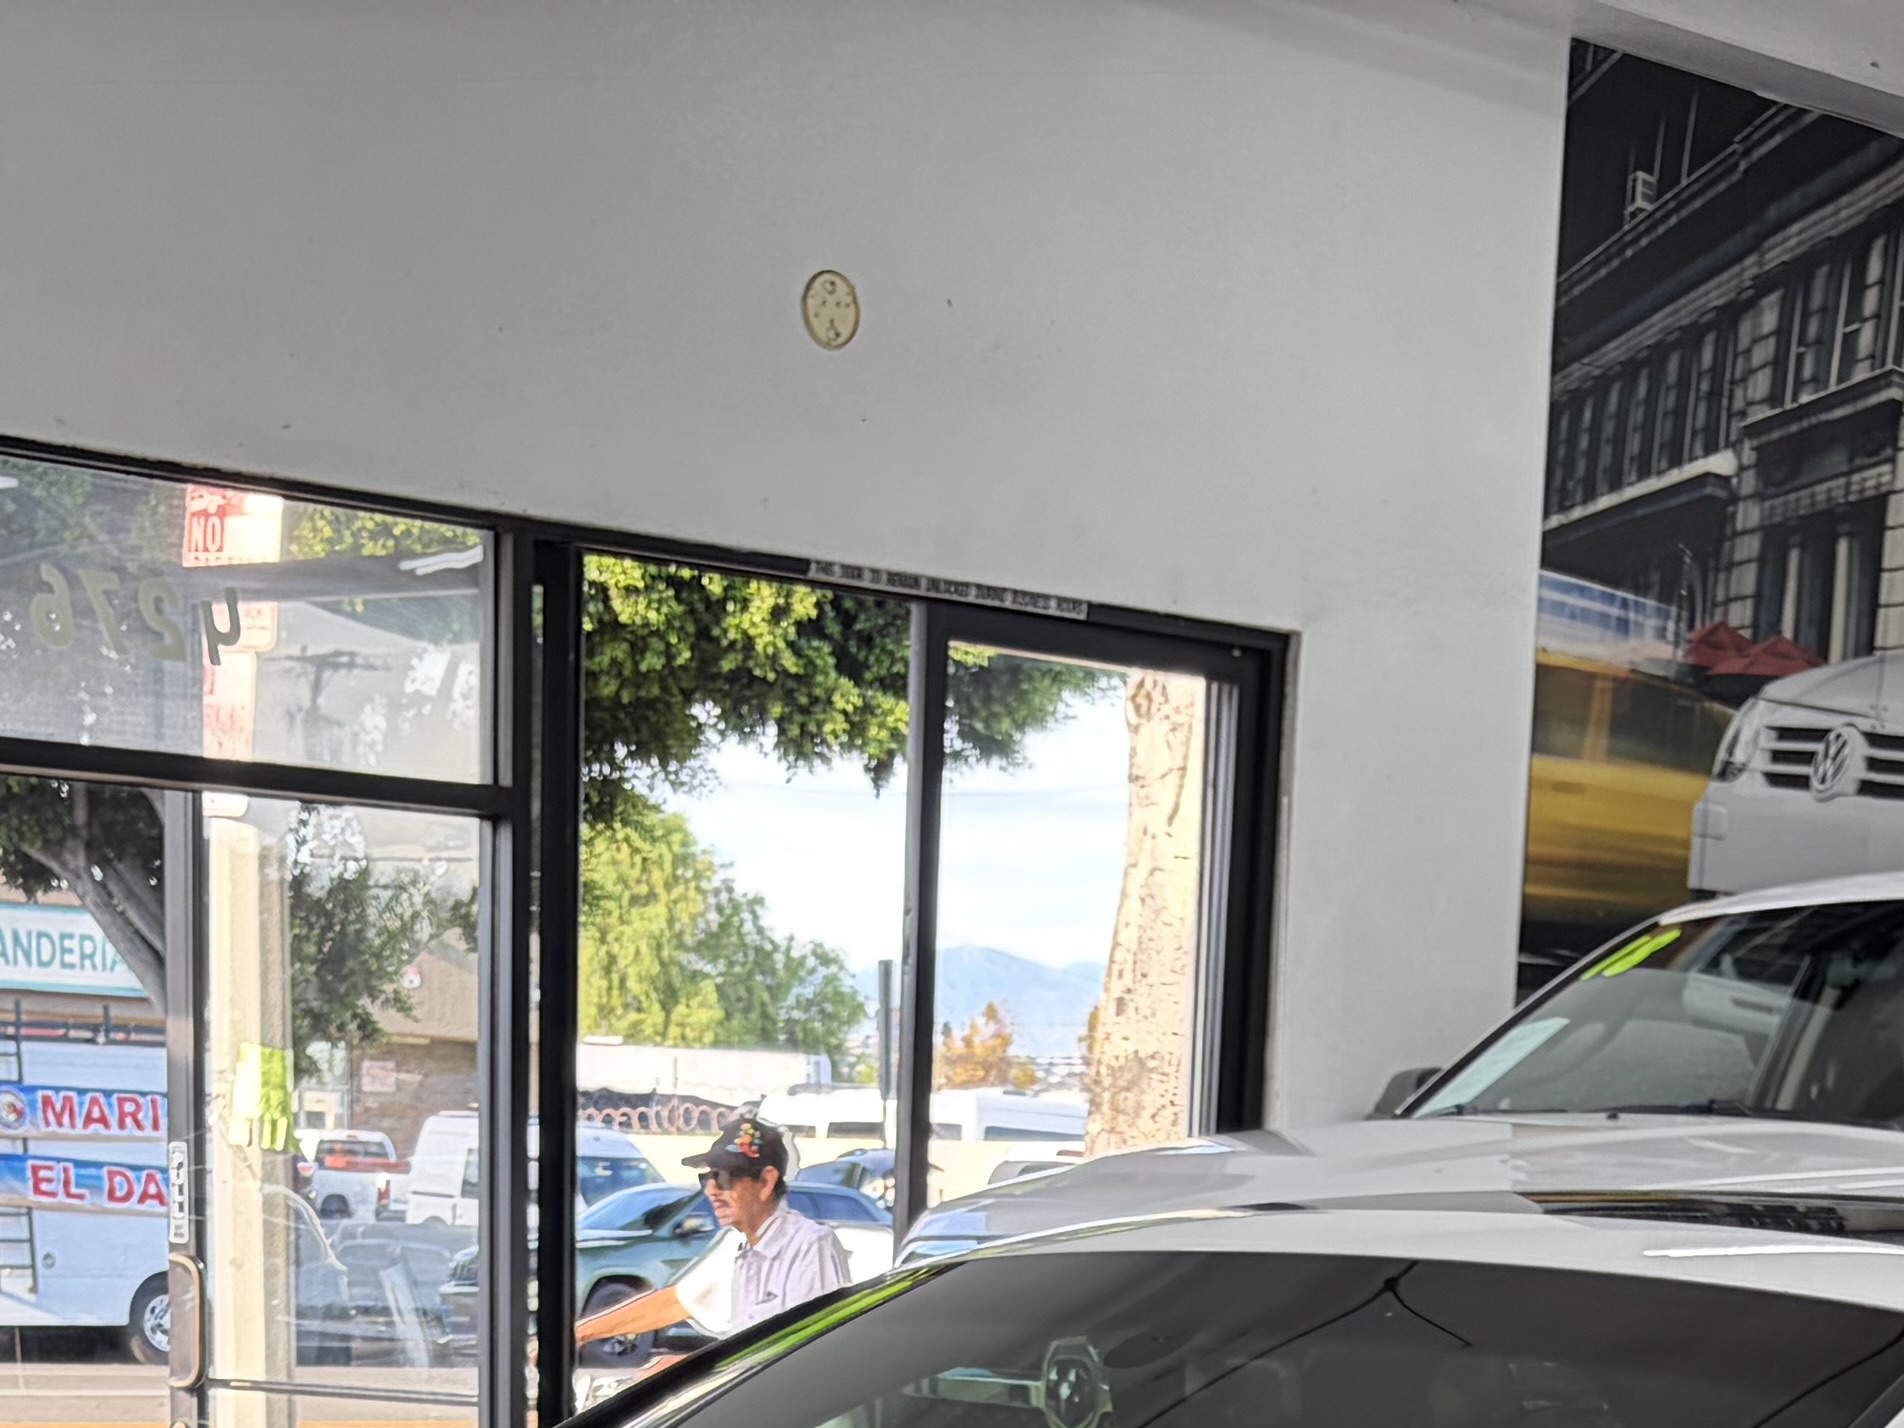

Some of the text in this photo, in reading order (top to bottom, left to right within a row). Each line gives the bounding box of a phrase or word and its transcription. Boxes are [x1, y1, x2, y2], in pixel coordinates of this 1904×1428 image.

[191, 514, 224, 553] NO
[40, 1093, 162, 1133] MARI
[29, 1163, 168, 1208] EL DA
